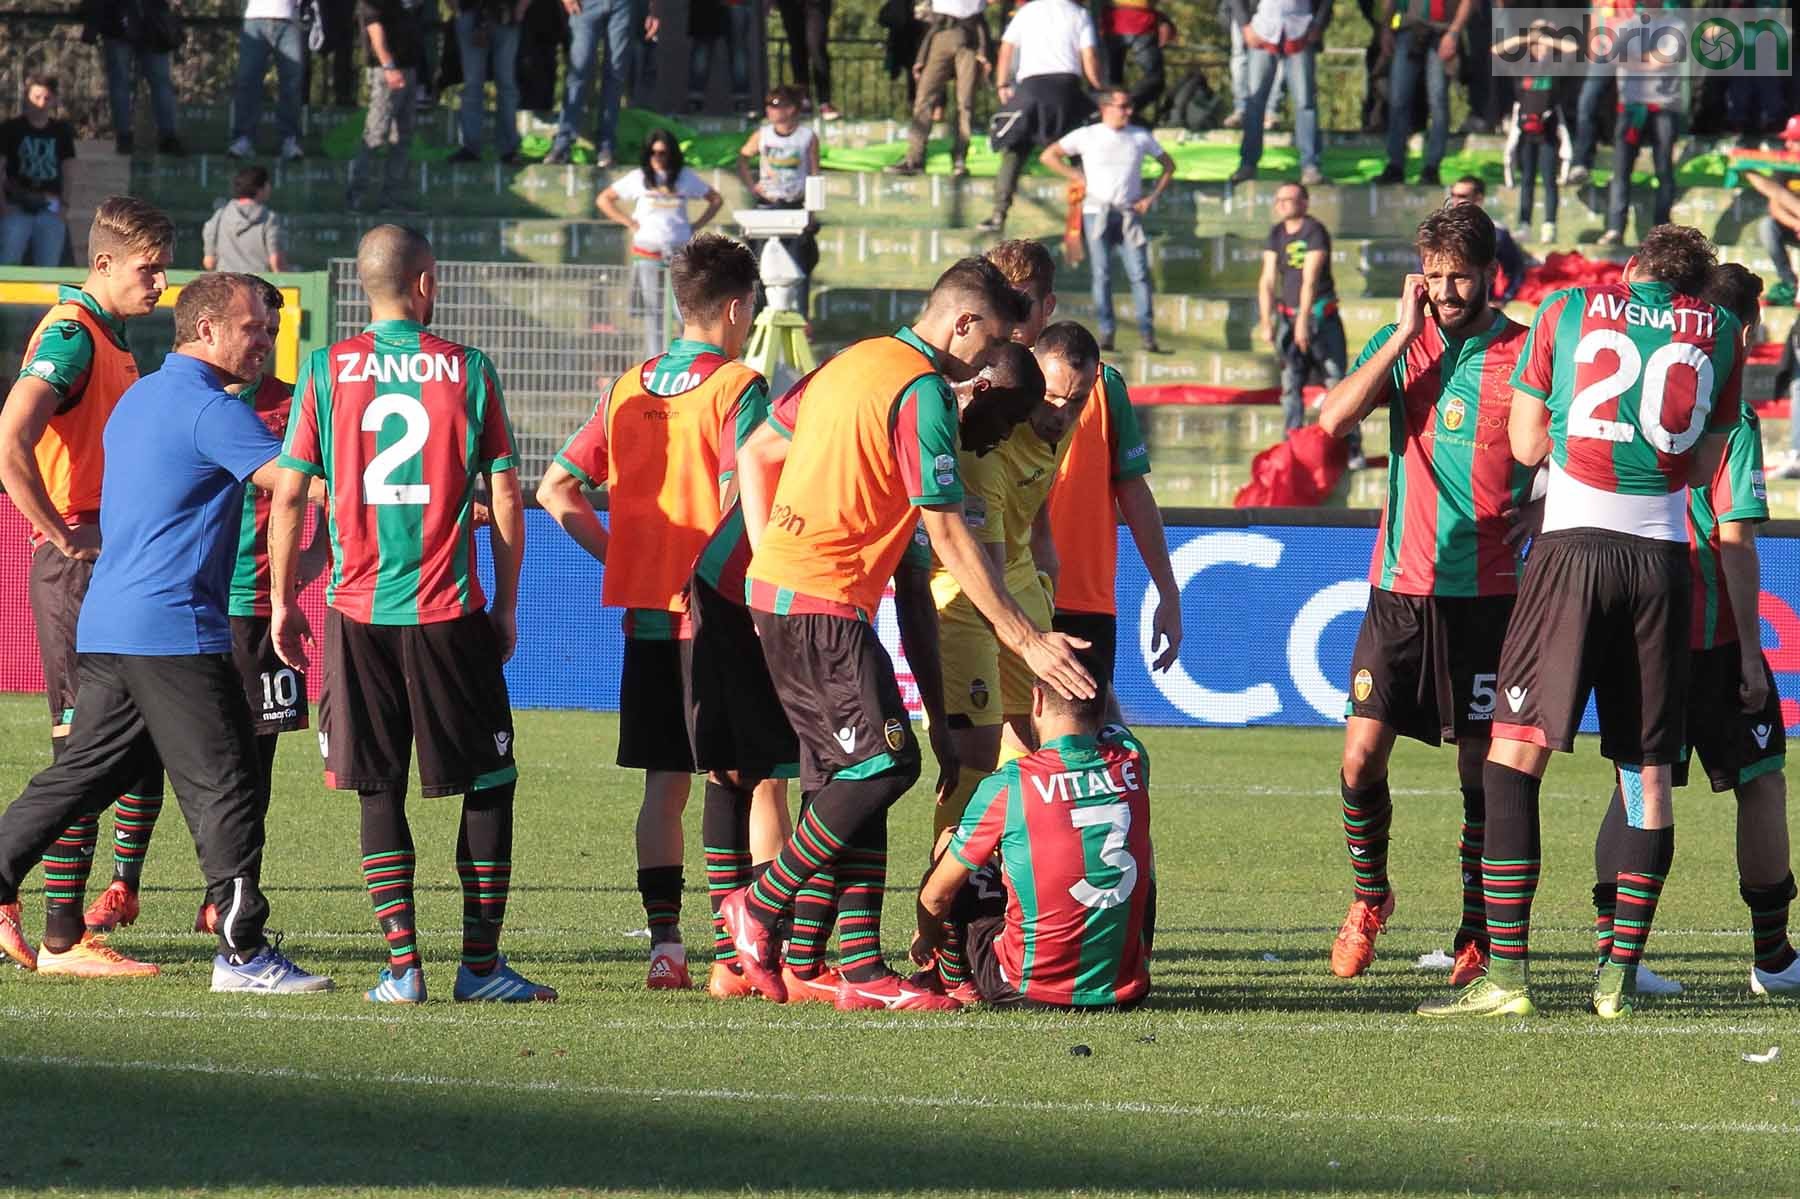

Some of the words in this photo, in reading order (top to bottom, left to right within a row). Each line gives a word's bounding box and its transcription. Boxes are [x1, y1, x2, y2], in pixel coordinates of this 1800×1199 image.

[1588, 293, 1713, 338] AVENATTI
[337, 352, 460, 383] ZANON
[1567, 328, 1715, 455] 20
[361, 393, 430, 505] 2
[260, 668, 297, 709] 10
[1469, 673, 1497, 713] 5
[263, 708, 297, 721] macron
[1031, 760, 1139, 804] VITALE
[1068, 801, 1138, 909] 3
